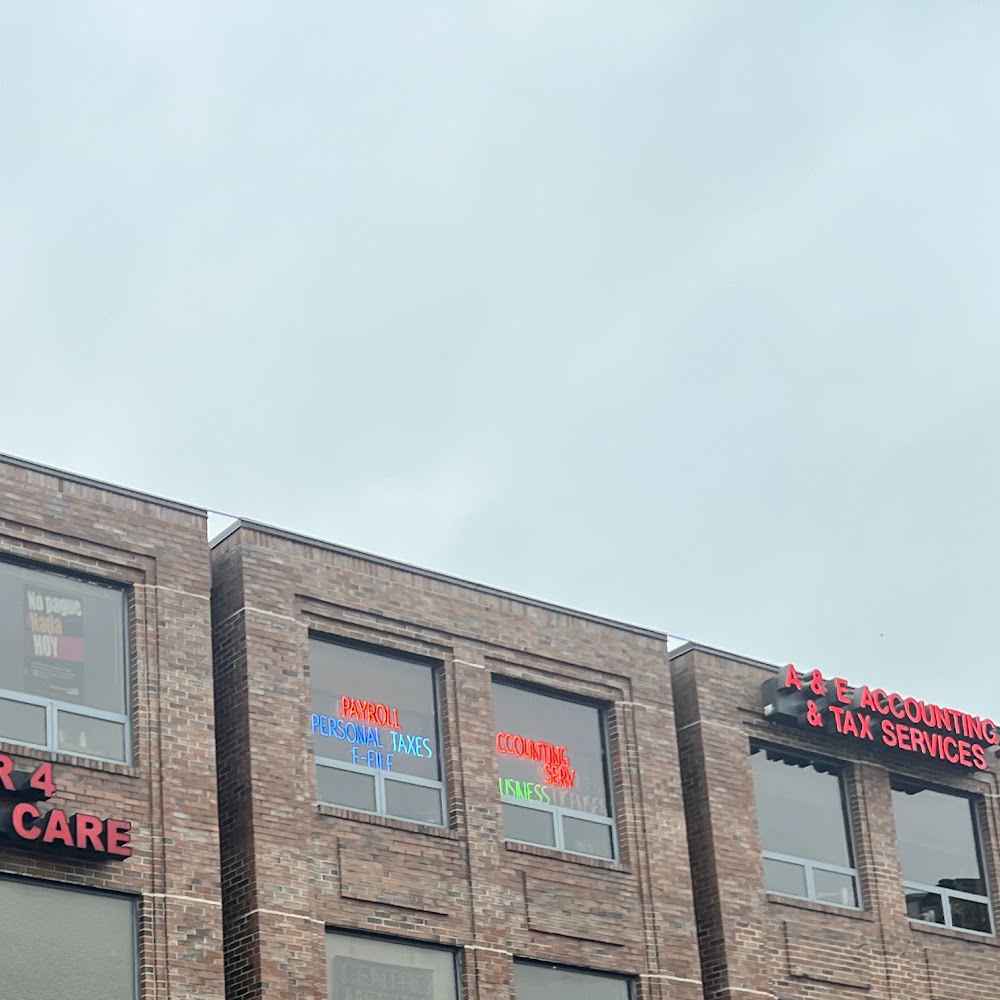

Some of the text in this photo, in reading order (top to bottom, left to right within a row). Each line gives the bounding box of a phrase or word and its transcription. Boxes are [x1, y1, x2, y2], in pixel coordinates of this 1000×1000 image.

[33, 634, 58, 657] HOY
[341, 695, 402, 730] PAYROLL
[785, 663, 999, 745] A & E ACCOUNTING
[311, 713, 433, 758] PERSONAL TAXES
[806, 700, 987, 770] & TAX SERVICES
[30, 763, 57, 798] 4
[12, 802, 133, 857] CARE
